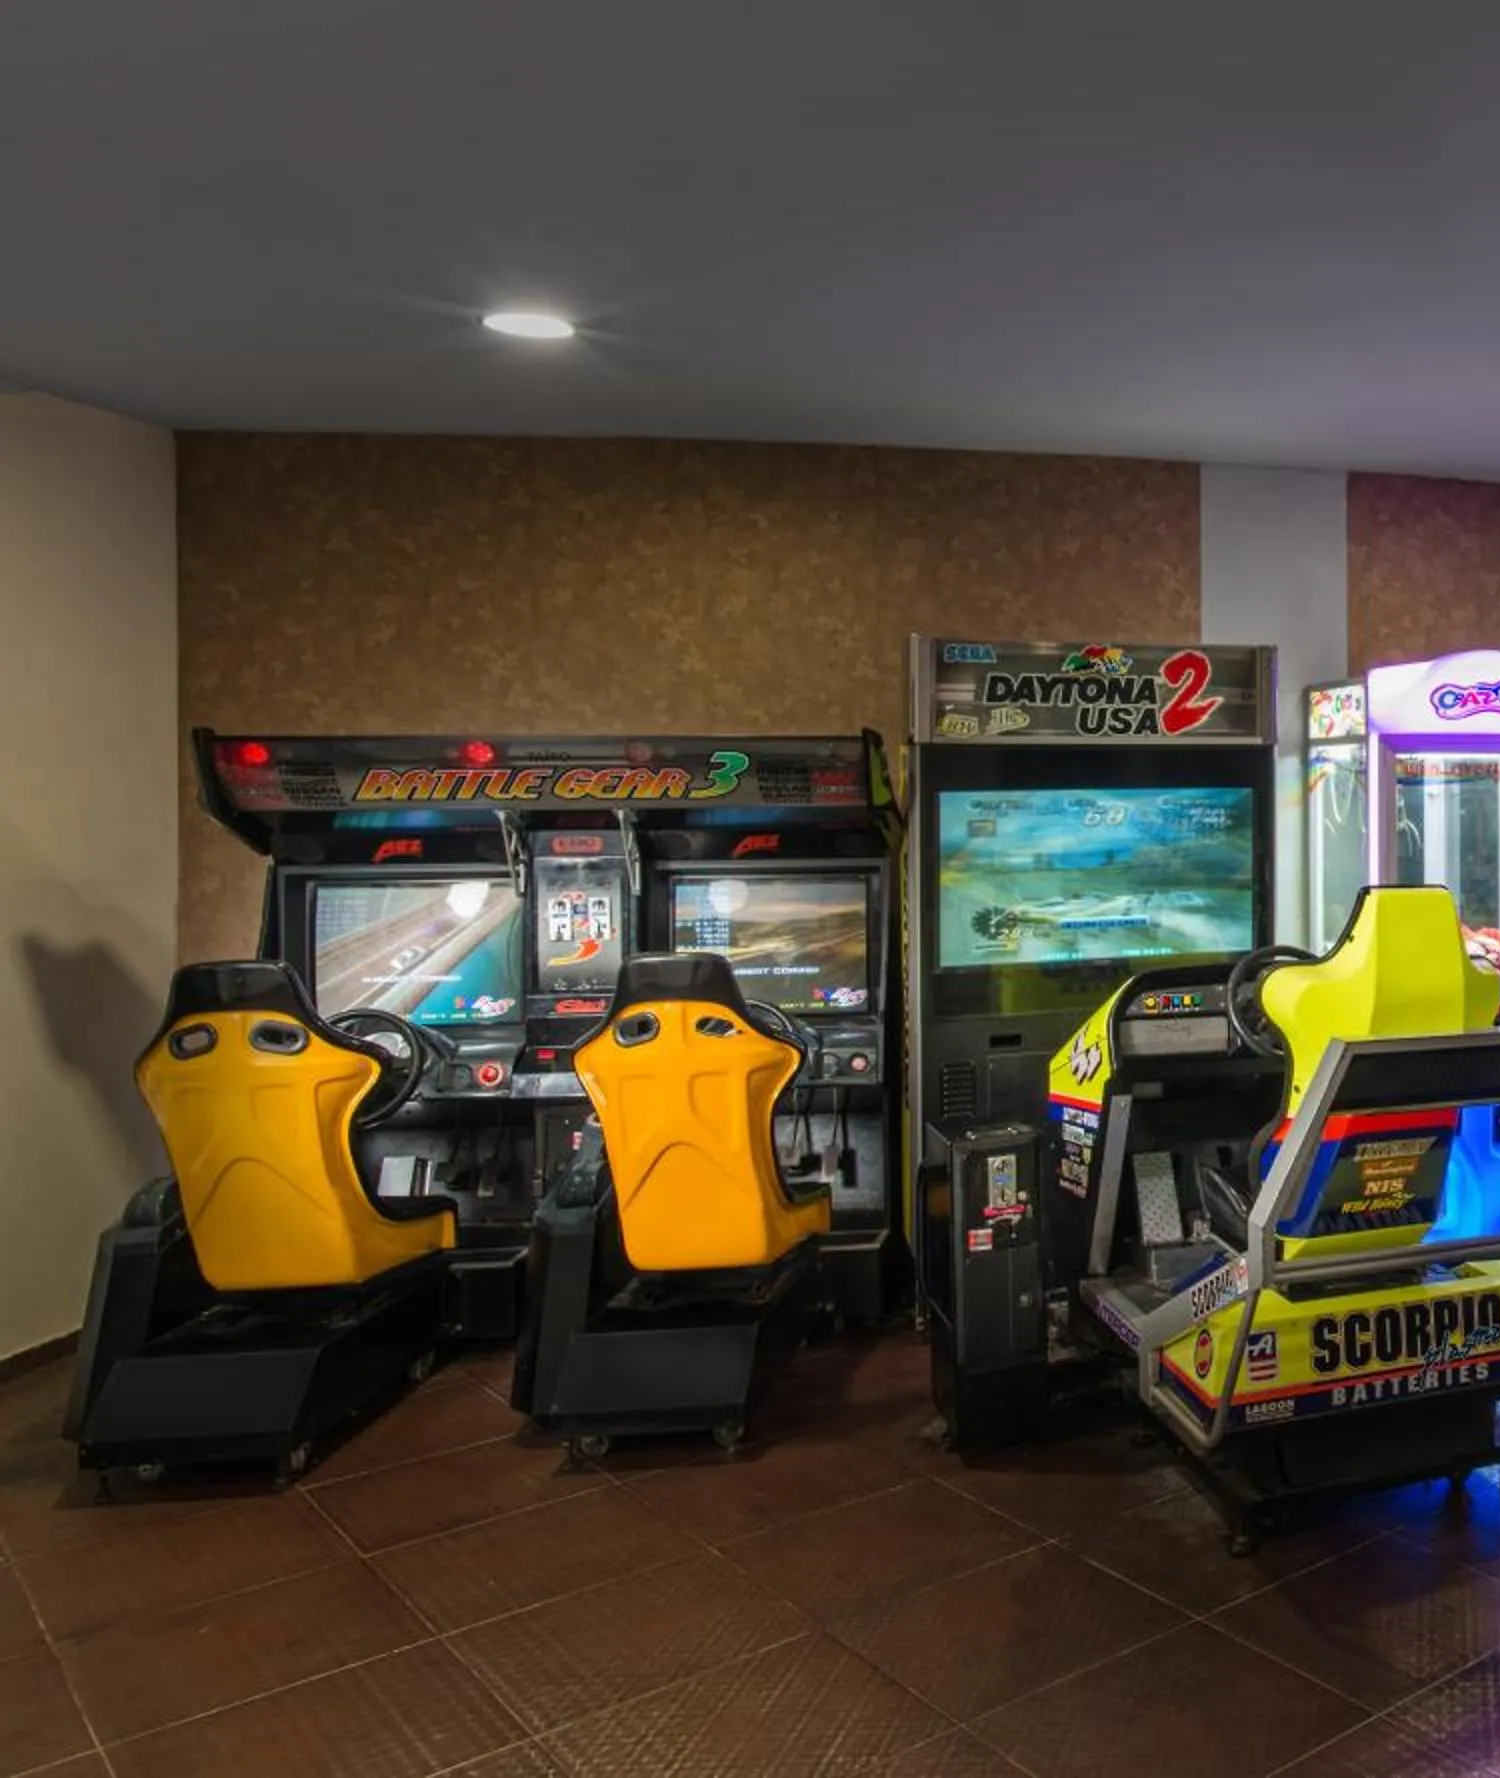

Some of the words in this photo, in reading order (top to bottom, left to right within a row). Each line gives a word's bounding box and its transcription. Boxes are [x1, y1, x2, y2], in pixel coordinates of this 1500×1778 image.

[944, 645, 996, 663] SEGA
[984, 674, 1160, 707] DAYTONA
[1159, 649, 1225, 736] 2
[1074, 704, 1161, 737] USA
[357, 768, 553, 801] BATTLE
[552, 768, 692, 801] GEAR
[689, 751, 750, 800] 3
[1331, 1363, 1490, 1406] BATTERIES
